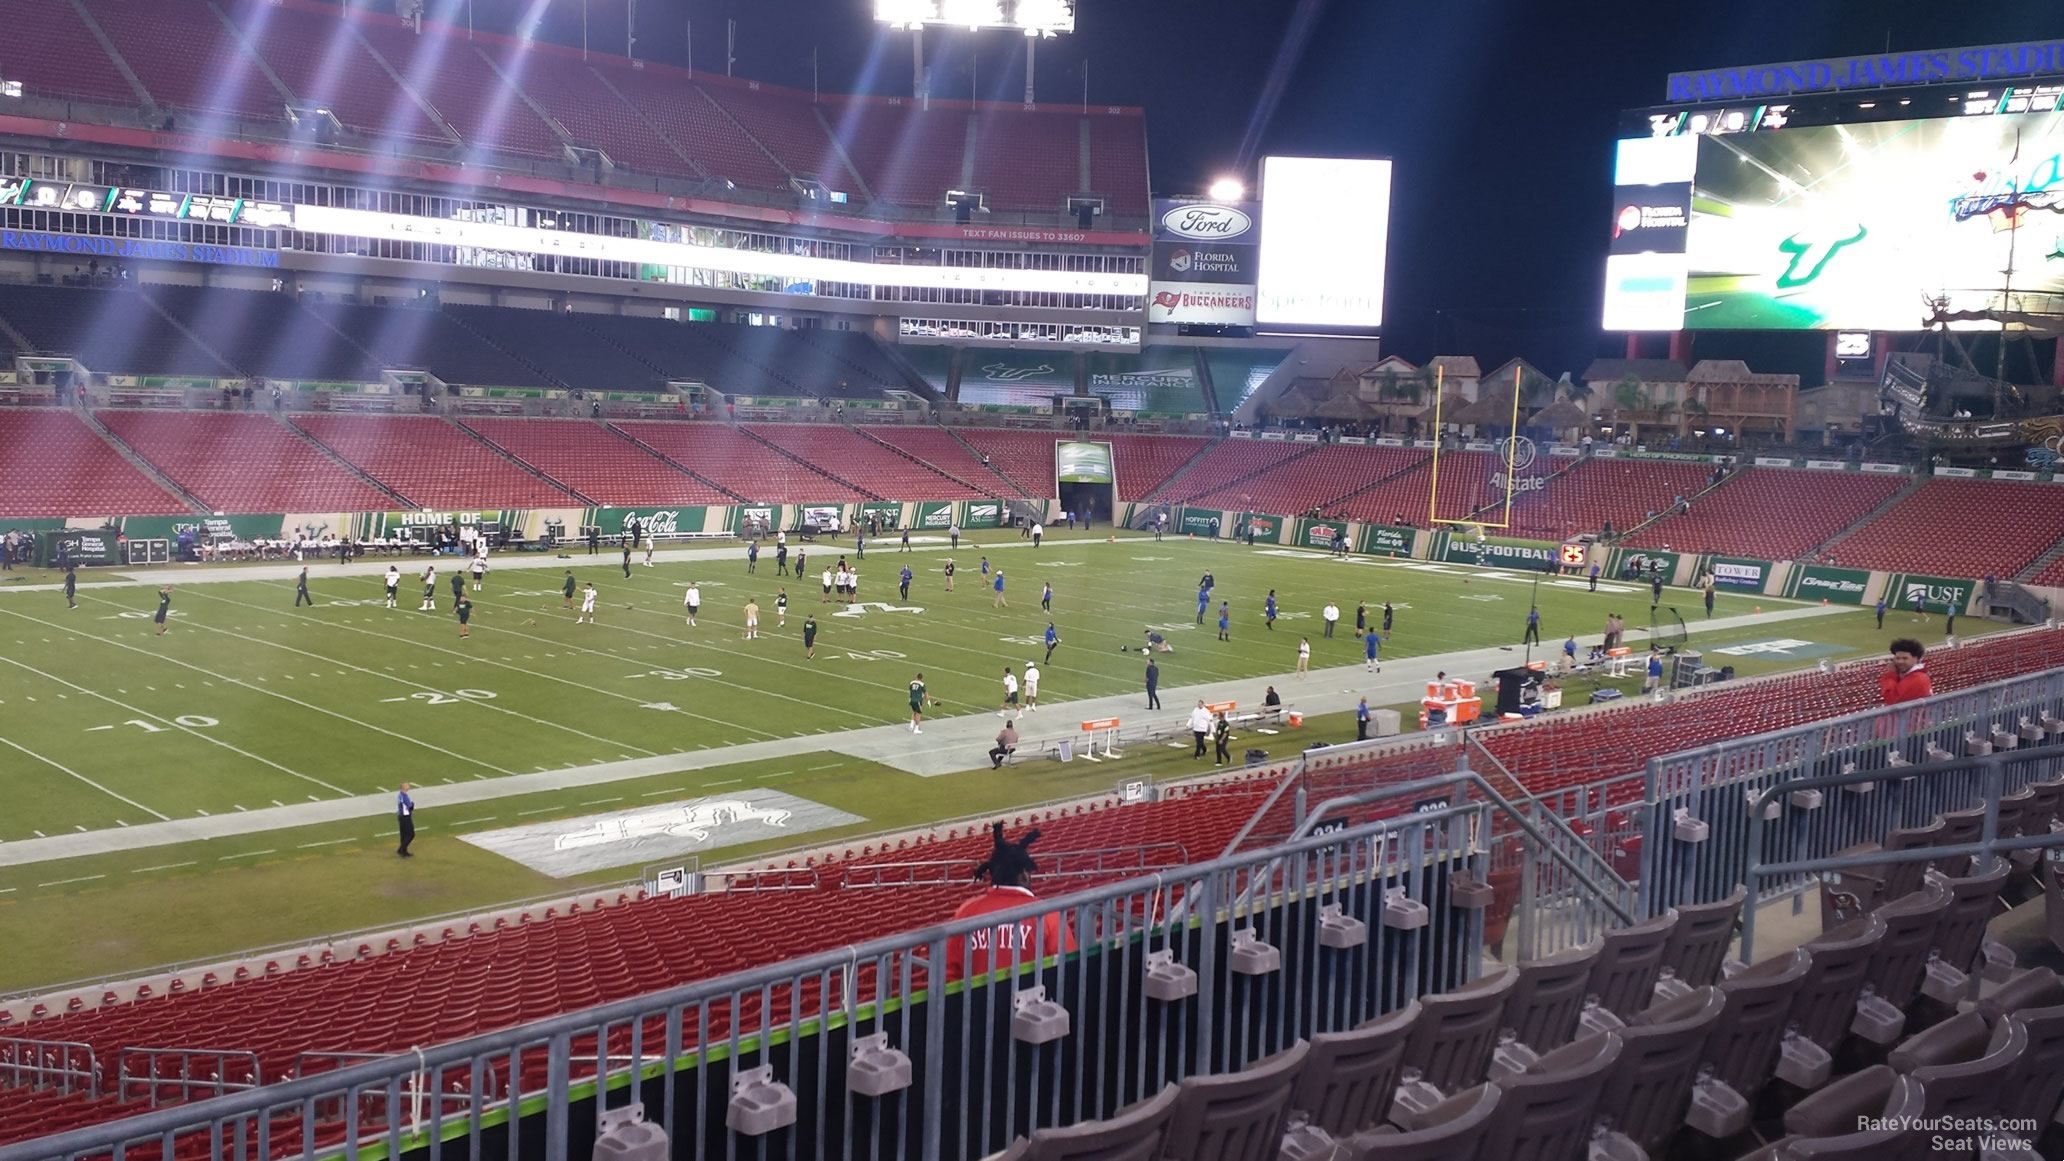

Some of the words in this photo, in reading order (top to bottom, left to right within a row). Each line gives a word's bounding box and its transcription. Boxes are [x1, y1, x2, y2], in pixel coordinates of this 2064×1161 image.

[1670, 63, 1832, 101] RAYMOND
[1836, 51, 1950, 87] JAMES
[1180, 209, 1233, 233] Ford
[963, 228, 987, 238] TEXT
[988, 230, 1006, 238] FAN
[1008, 231, 1041, 240] ISSUES
[1043, 232, 1055, 241] TO
[1057, 233, 1085, 242] 33607
[2, 231, 116, 255] RAYMOND
[118, 241, 191, 260] JAMES
[192, 246, 280, 268] STADIUM
[1194, 251, 1235, 263] FLORIDA
[1194, 261, 1240, 272] HOSPITAL
[1183, 294, 1251, 311] BUCCANEERS
[1092, 374, 1192, 383] MERCURY
[1093, 380, 1195, 388] INSURANCE
[1489, 472, 1545, 491] Allstate
[401, 513, 453, 525] HOME
[460, 512, 480, 524] OF
[1377, 530, 1402, 539] Florida
[1563, 546, 1584, 562] 25
[1717, 566, 1759, 577] TOWER
[1928, 585, 1964, 601] USF
[649, 667, 722, 680] 30
[411, 688, 498, 705] 20
[123, 715, 219, 733] 10
[971, 924, 1032, 950] SETY
